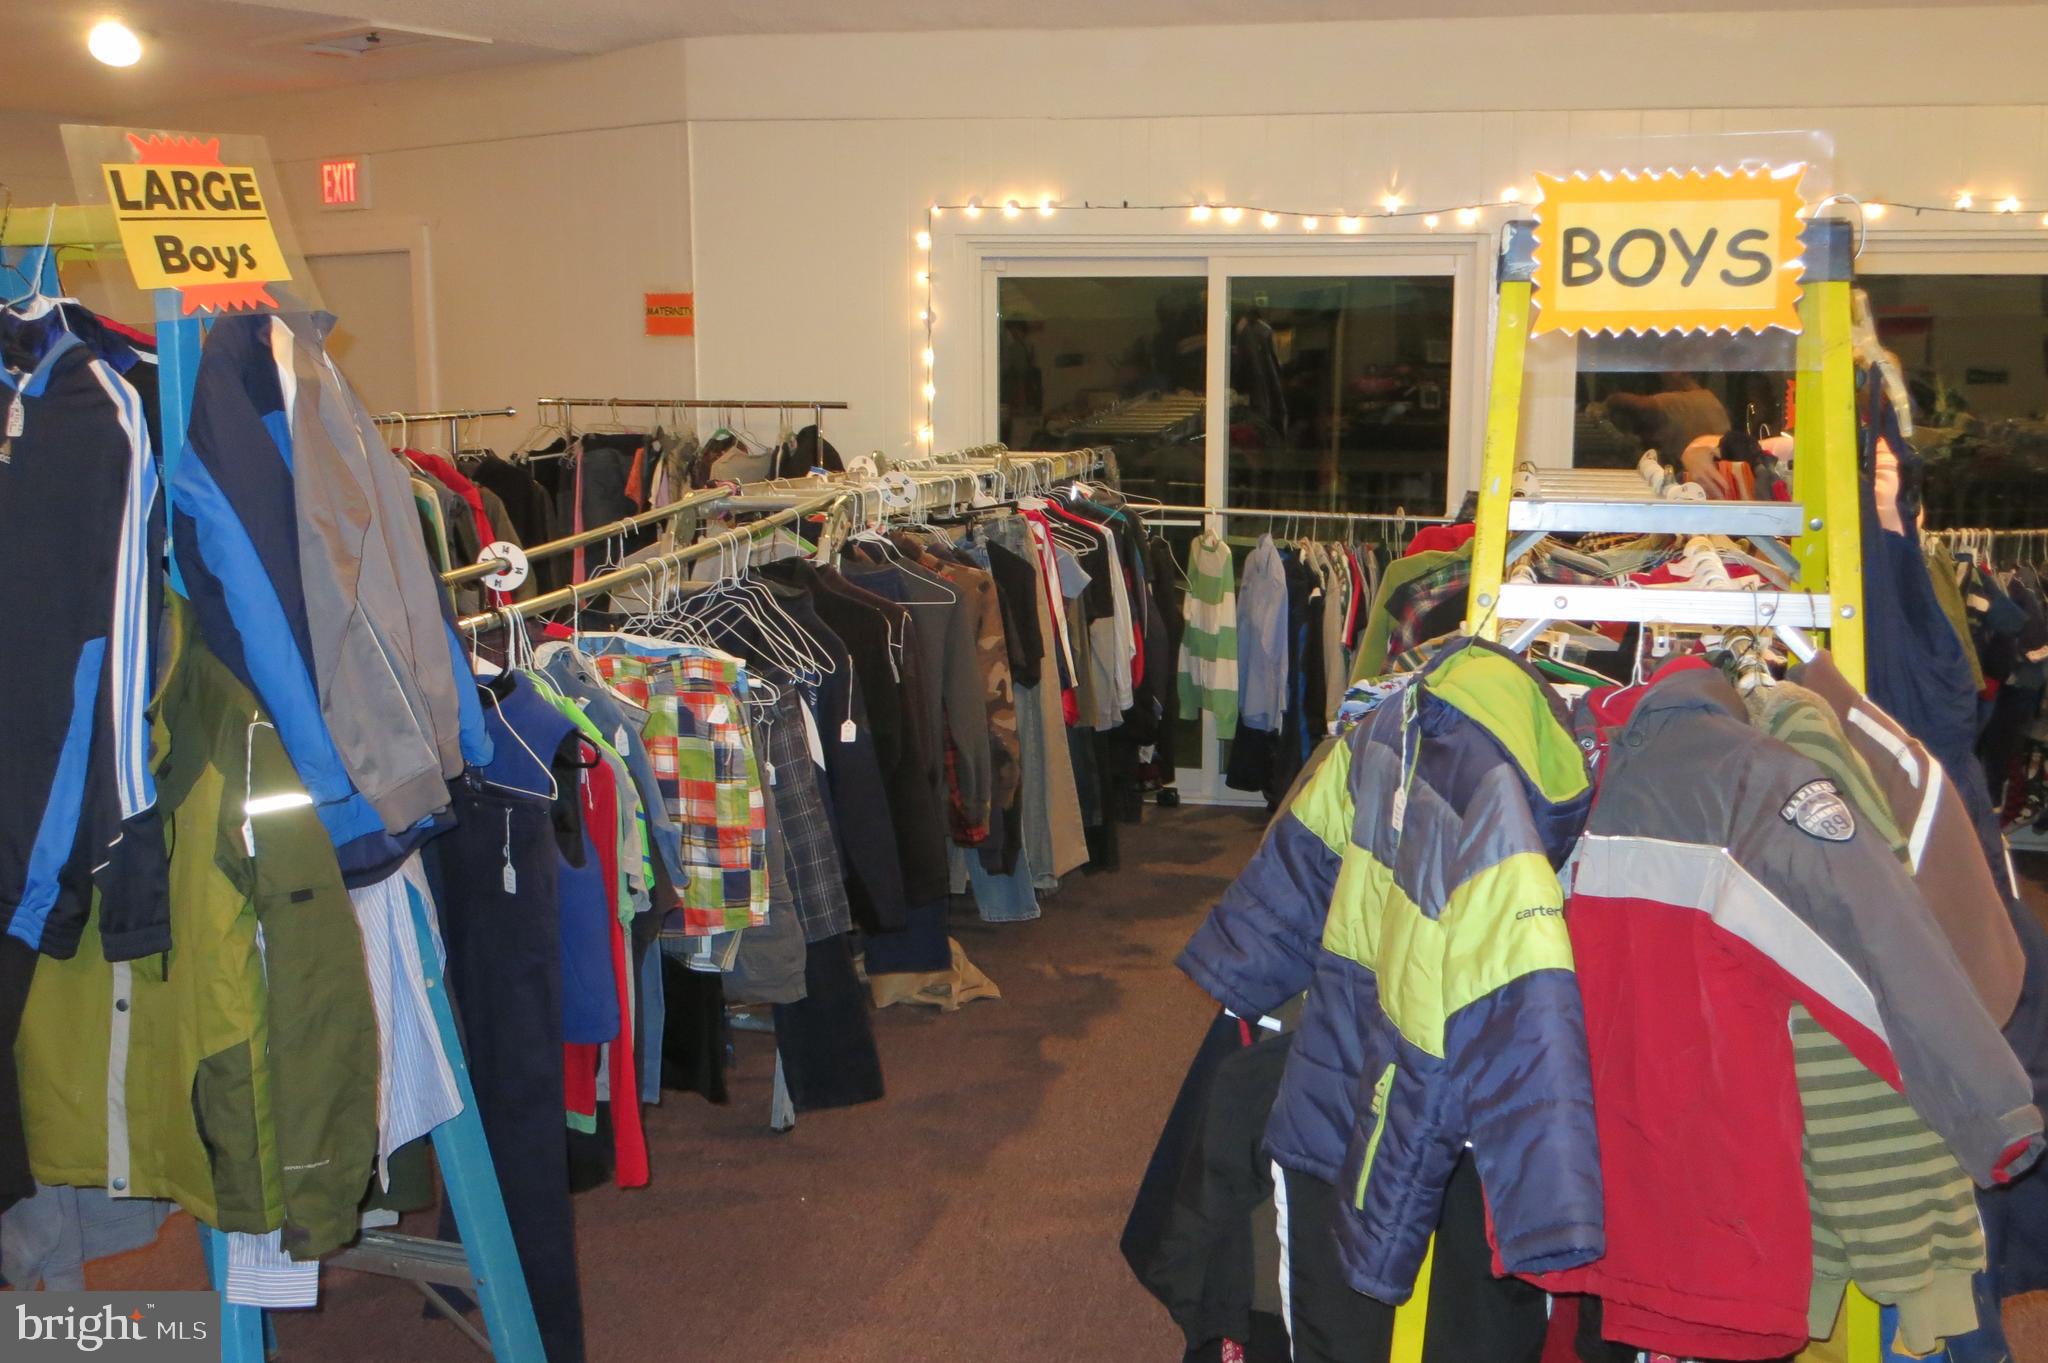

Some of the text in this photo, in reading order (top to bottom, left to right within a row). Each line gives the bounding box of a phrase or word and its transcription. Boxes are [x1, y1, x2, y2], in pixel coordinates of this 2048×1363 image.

[109, 169, 262, 211] LARGE
[322, 162, 356, 203] EXIT
[153, 235, 257, 279] Boys
[1561, 226, 1773, 288] BOYS
[1820, 813, 1850, 837] 89
